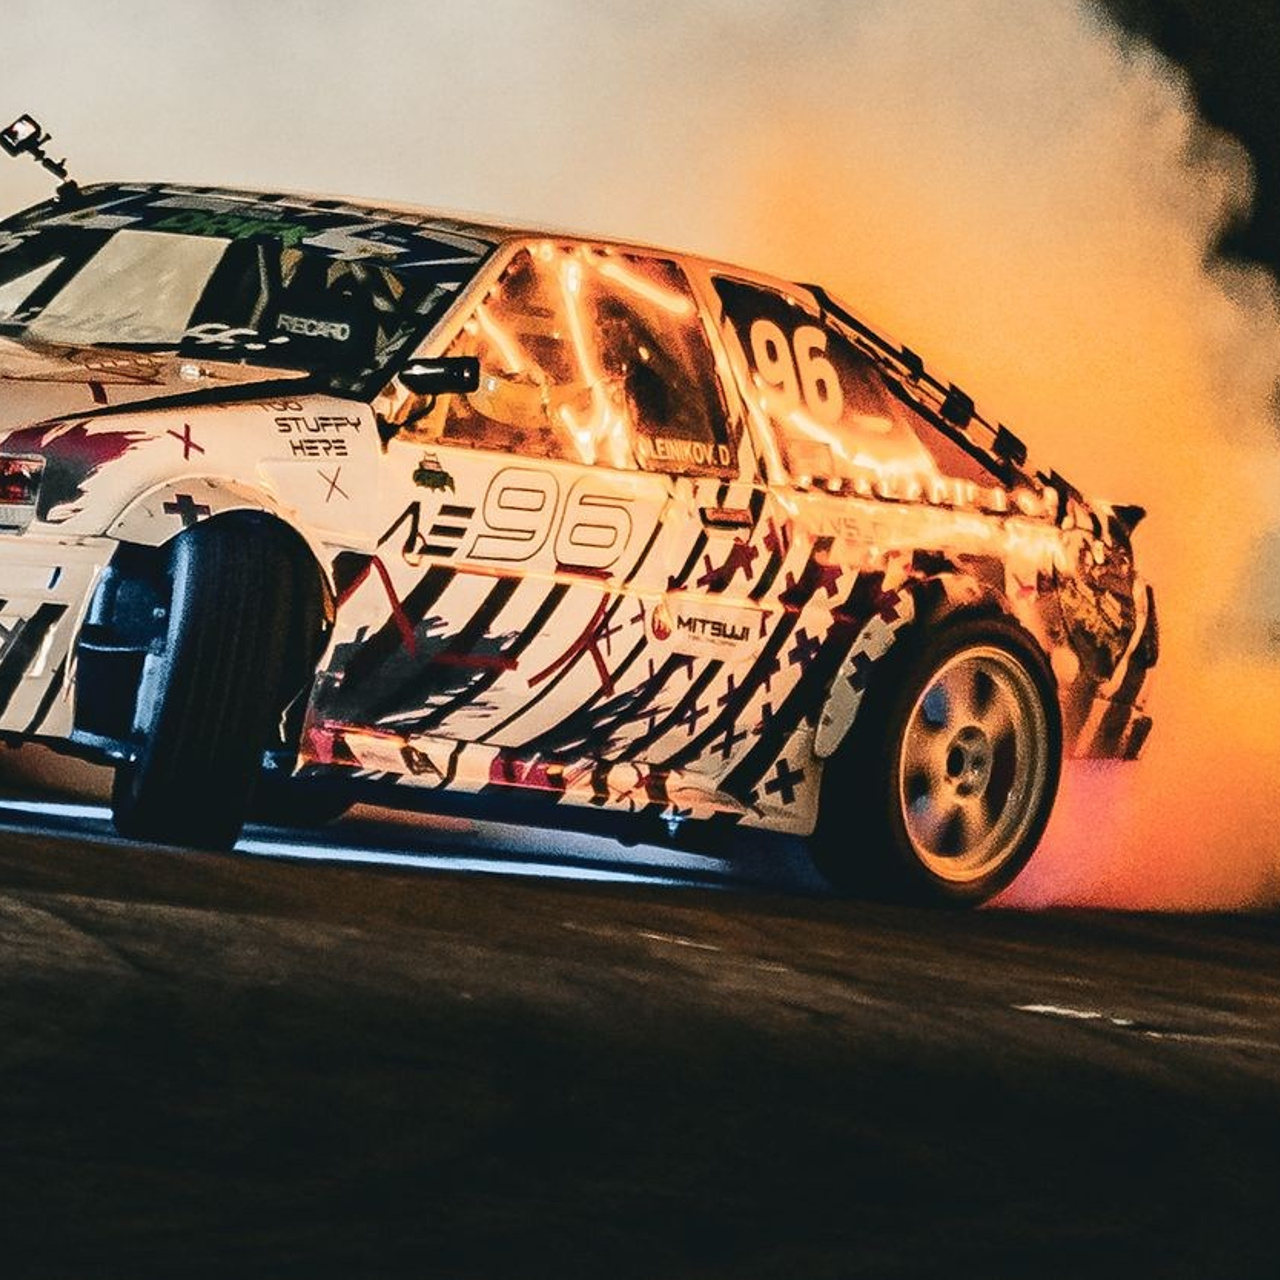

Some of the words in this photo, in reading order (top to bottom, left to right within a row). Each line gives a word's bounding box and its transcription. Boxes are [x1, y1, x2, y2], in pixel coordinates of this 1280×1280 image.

[276, 314, 350, 342] RECARO
[750, 319, 843, 425] 96
[274, 416, 361, 433] STUFFY
[289, 439, 348, 456] HERE
